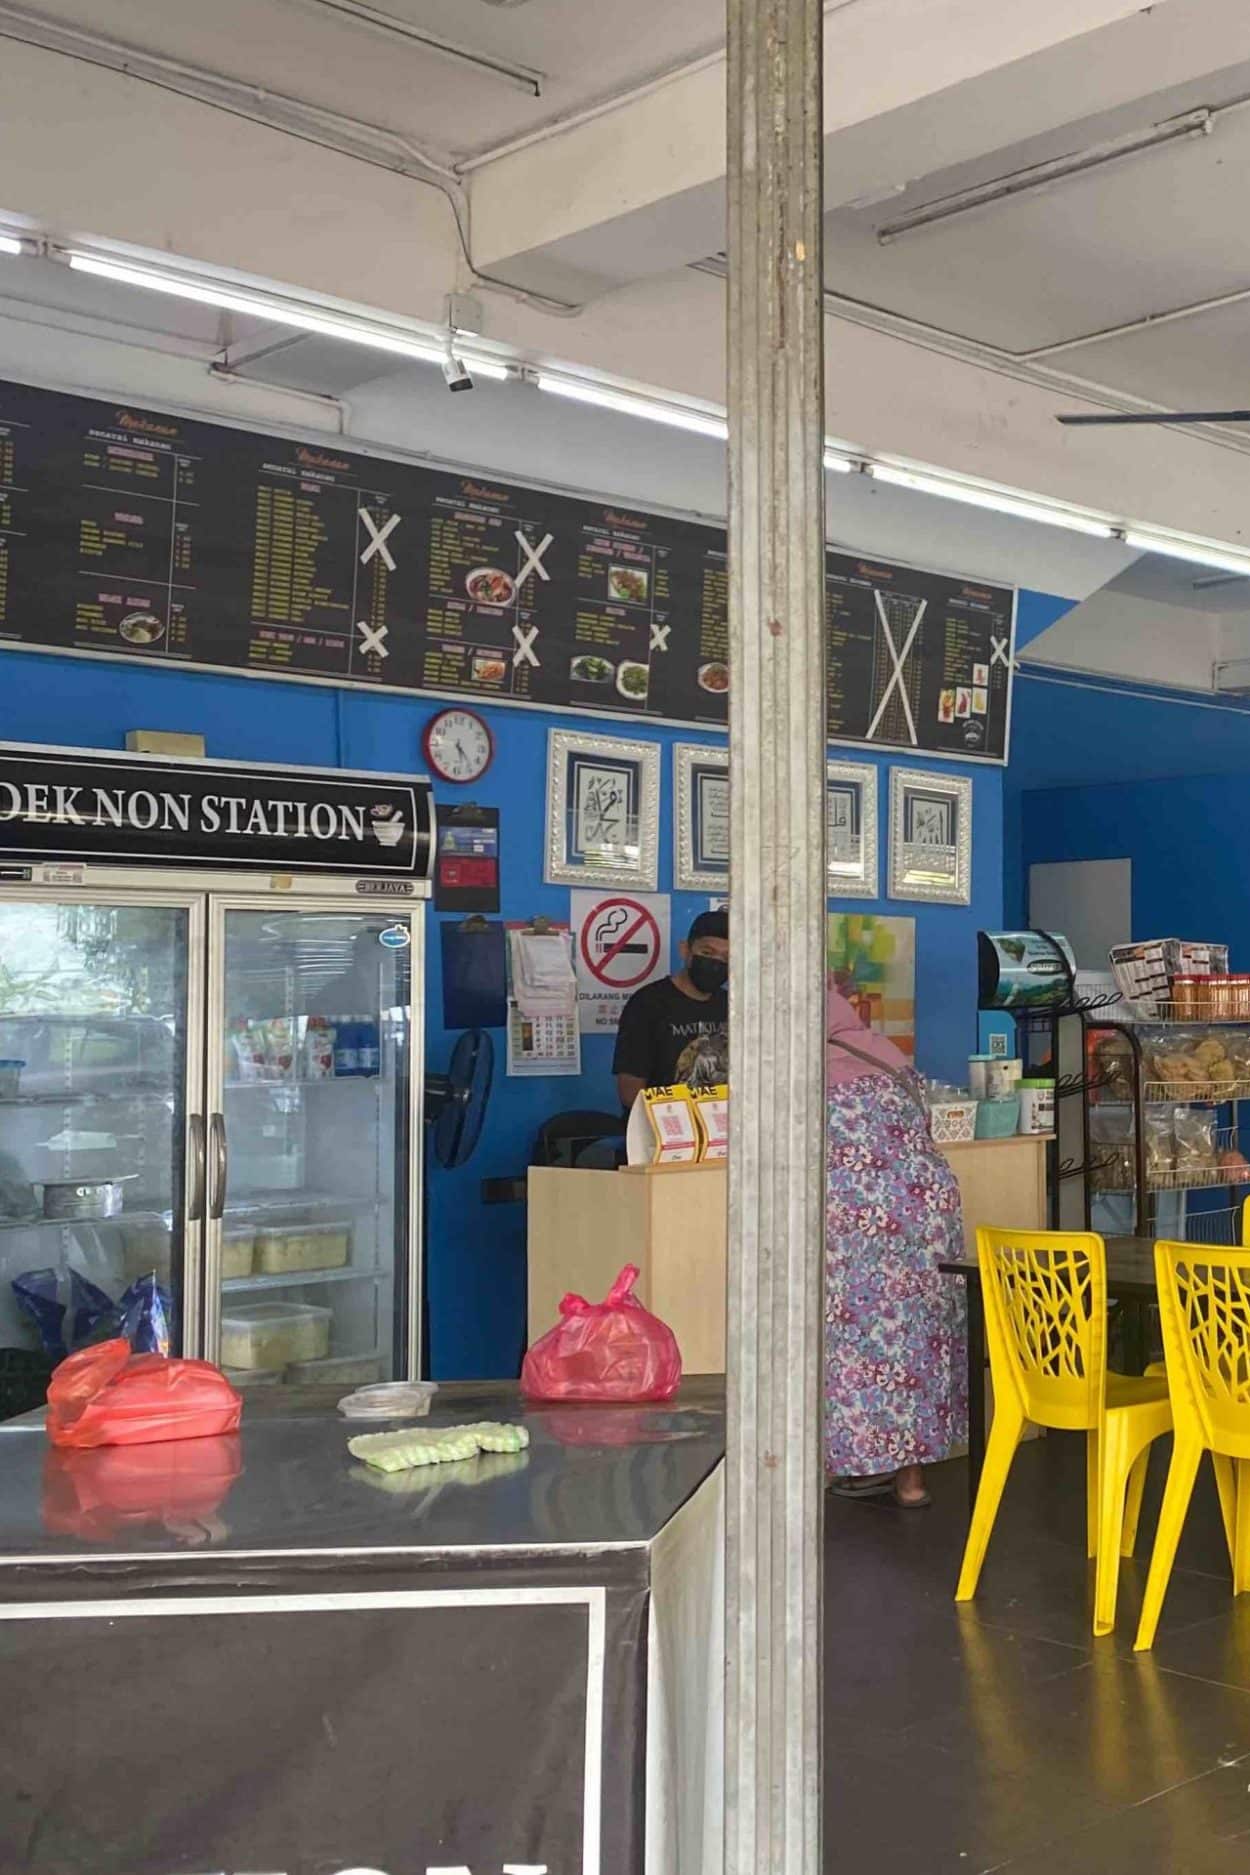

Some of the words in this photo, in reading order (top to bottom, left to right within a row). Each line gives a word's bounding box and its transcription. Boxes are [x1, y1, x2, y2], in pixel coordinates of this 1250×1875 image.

[0, 781, 86, 826] DEK
[92, 788, 192, 832] NON
[200, 795, 367, 841] STATION
